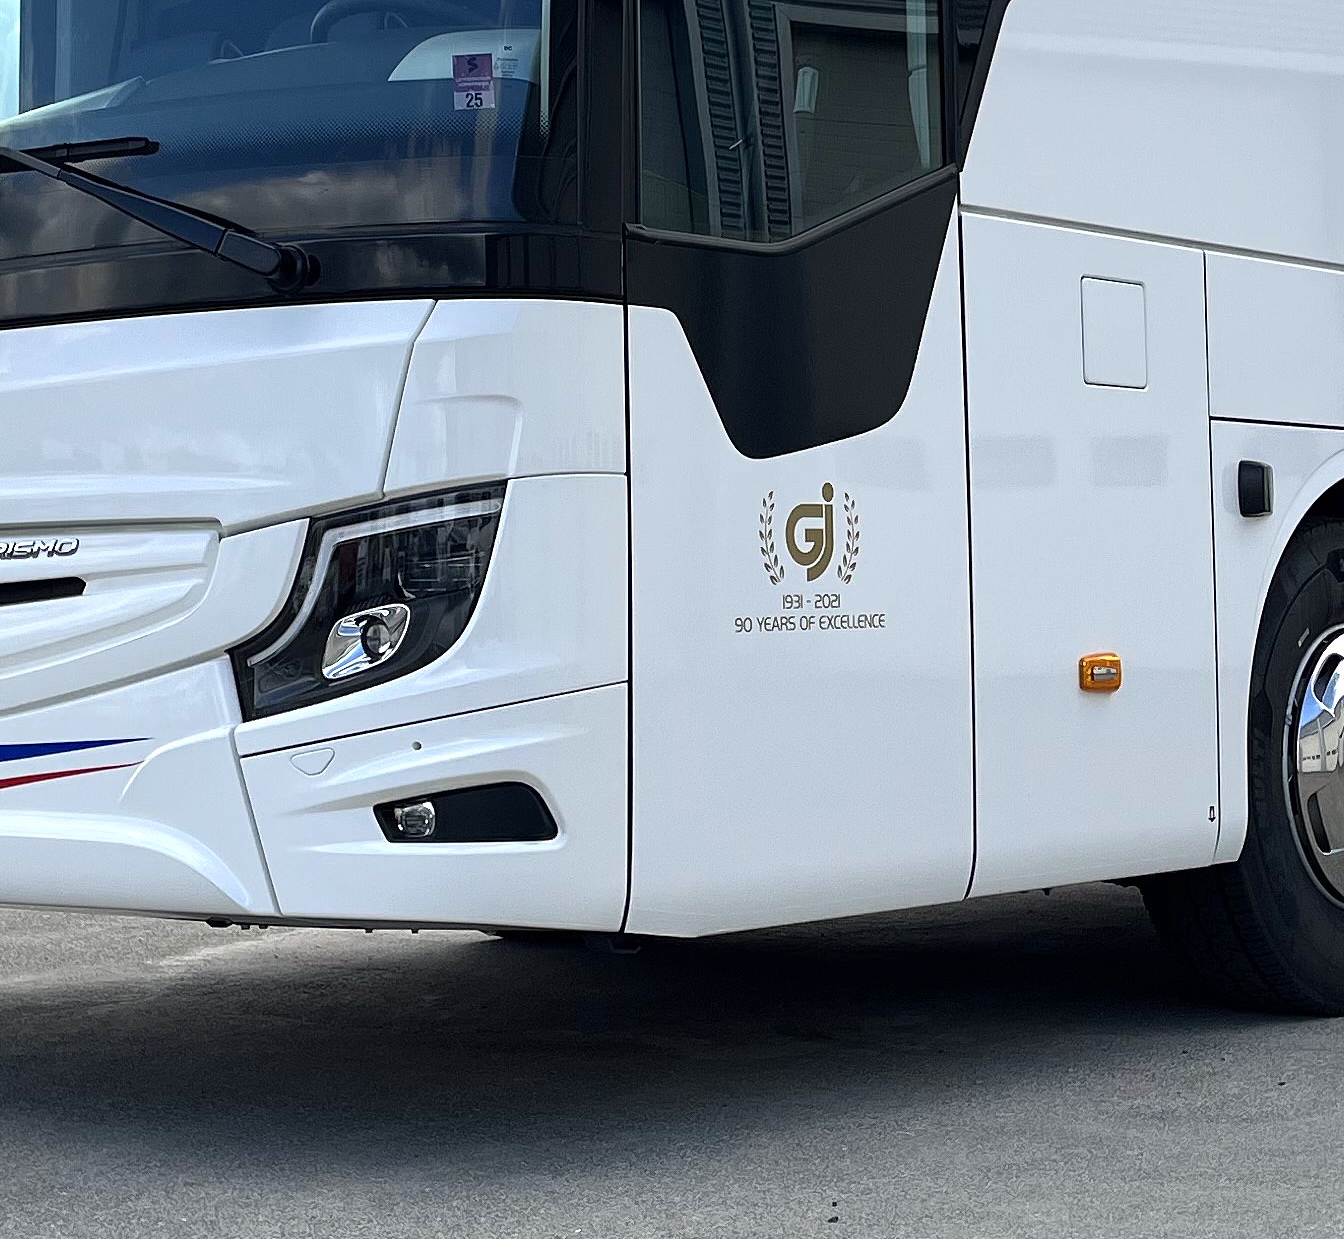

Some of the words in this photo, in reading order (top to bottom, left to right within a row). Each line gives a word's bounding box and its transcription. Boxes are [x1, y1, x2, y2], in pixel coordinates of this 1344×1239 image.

[465, 92, 484, 108] 25
[782, 594, 804, 610] 1931
[814, 593, 841, 609] 2021
[734, 617, 753, 633] 90
[756, 615, 797, 632] YEARS
[799, 614, 816, 631] OF
[819, 613, 886, 630] EXCELLENCE
